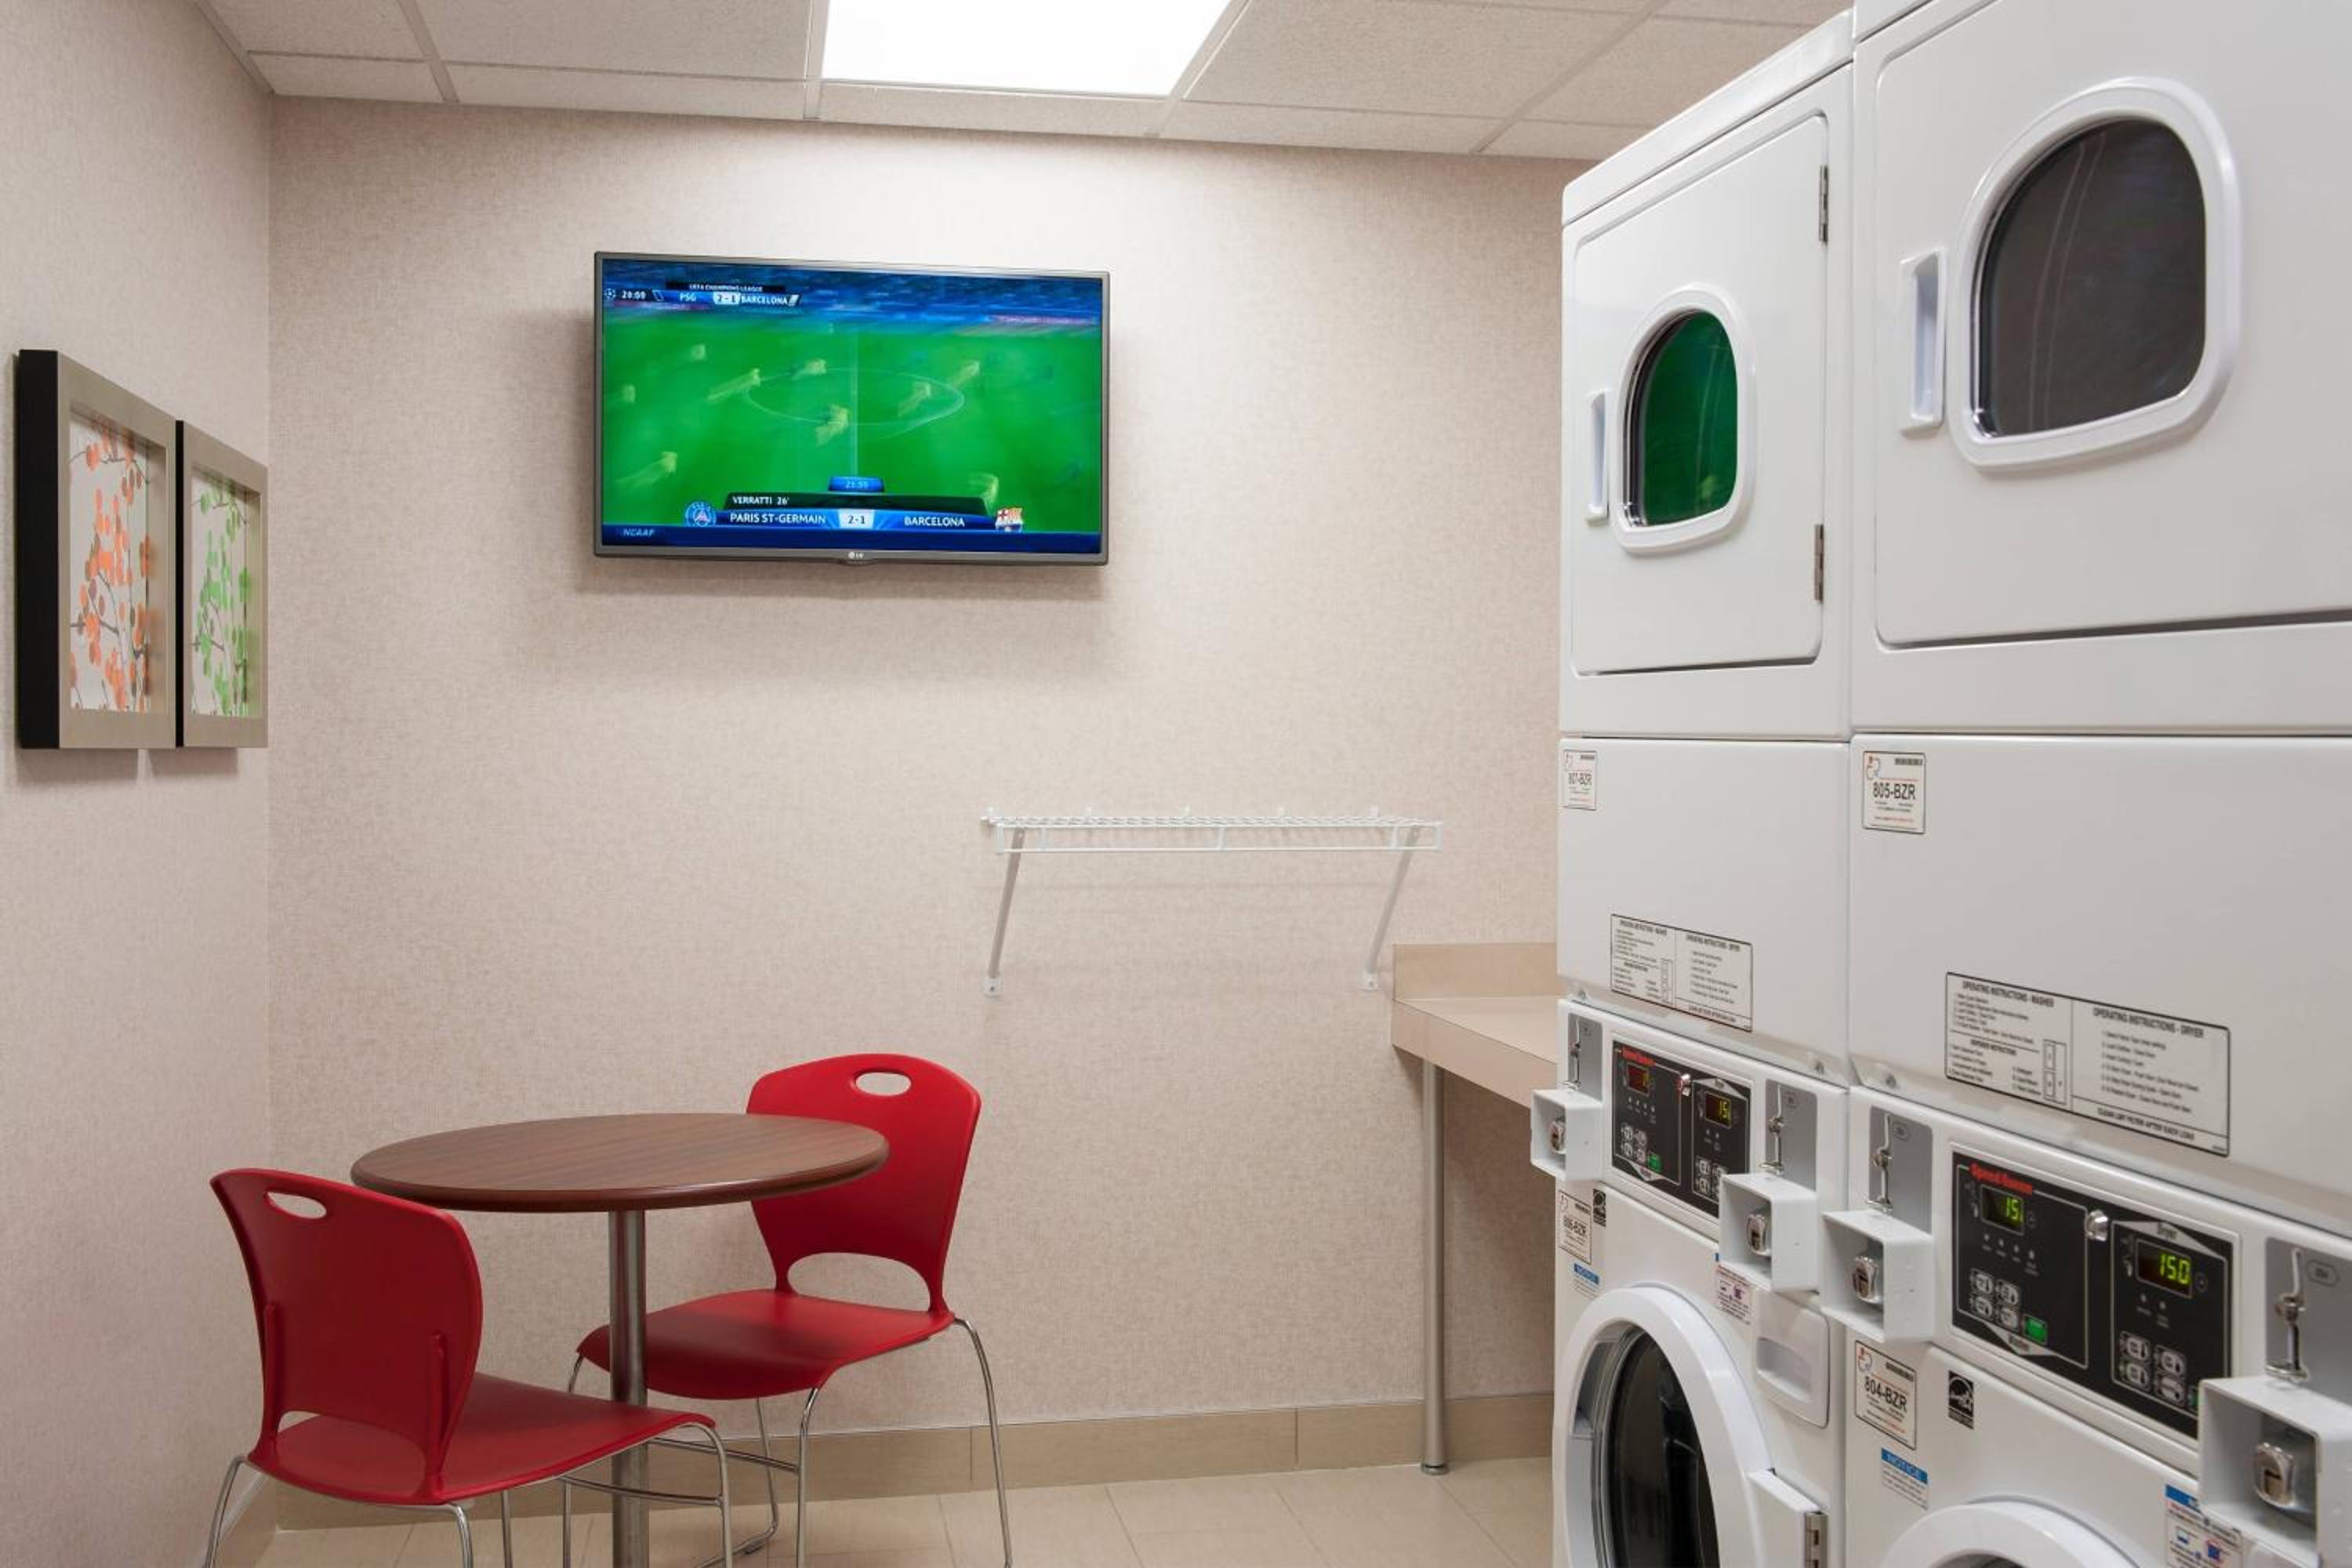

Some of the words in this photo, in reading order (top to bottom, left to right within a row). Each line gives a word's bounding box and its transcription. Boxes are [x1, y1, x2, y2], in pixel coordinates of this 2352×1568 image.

[680, 292, 697, 301] PSG
[741, 295, 788, 305] BARCELONA
[732, 495, 772, 505] VERRATTI
[730, 513, 760, 523] PARIS
[761, 514, 826, 524] ST-GERMAIN
[848, 516, 866, 524] 2-1
[904, 516, 965, 527] BARCELONA
[1873, 782, 1915, 800] 805-BZR
[2006, 1196, 2019, 1220] 15
[1865, 1376, 1907, 1414] 804-BZR
